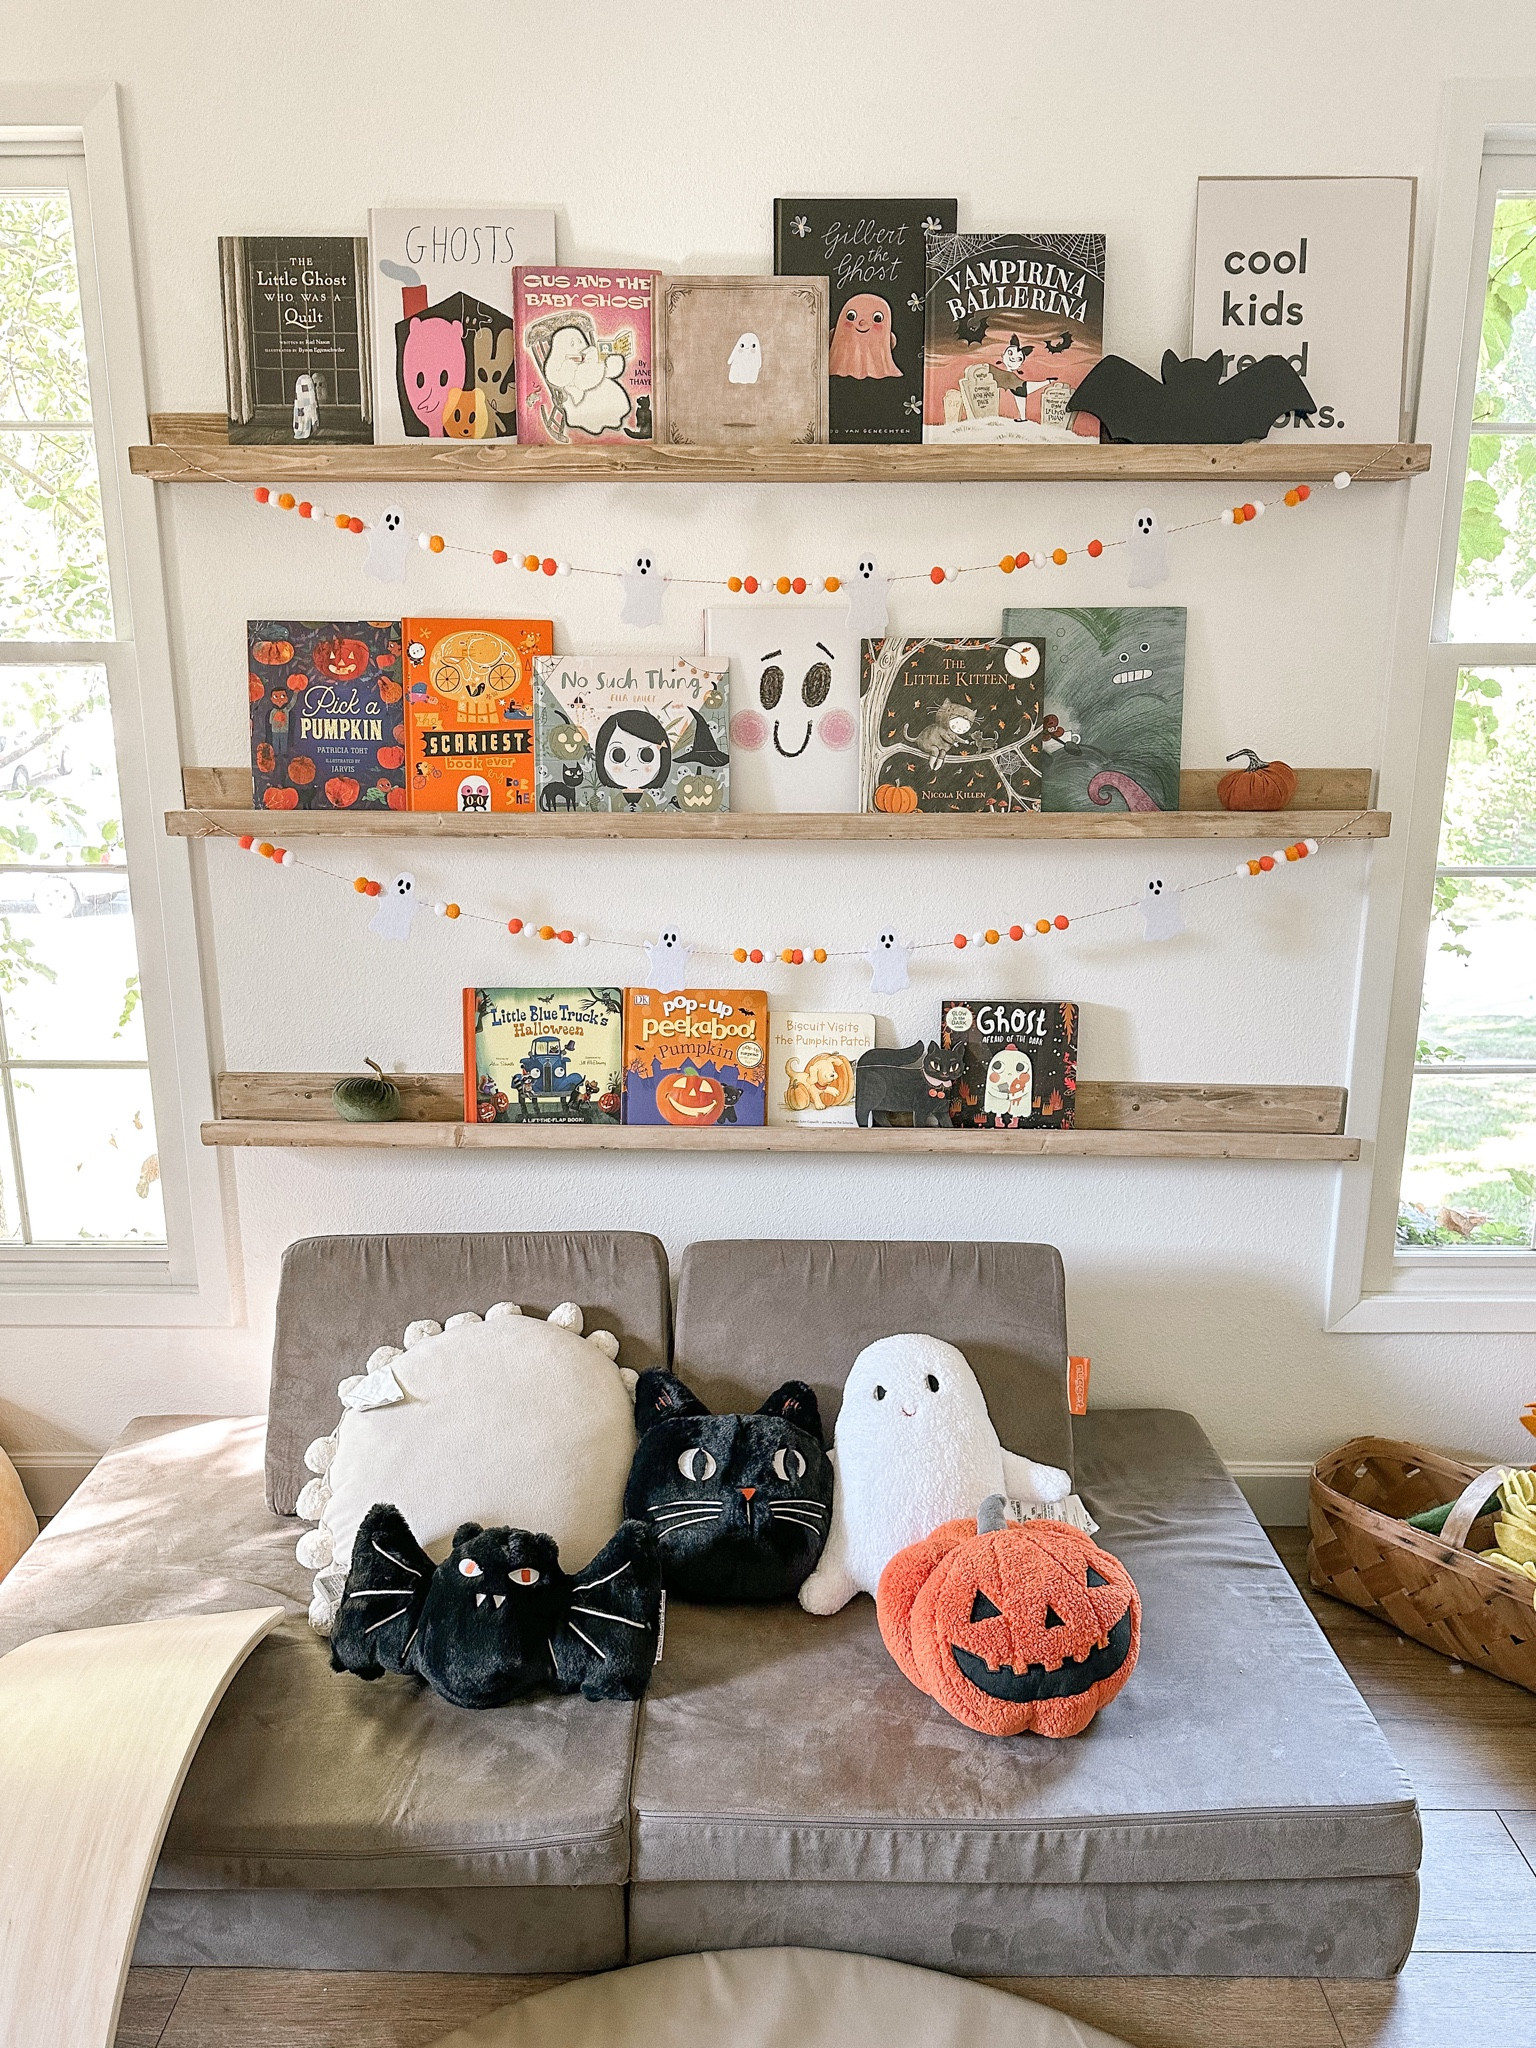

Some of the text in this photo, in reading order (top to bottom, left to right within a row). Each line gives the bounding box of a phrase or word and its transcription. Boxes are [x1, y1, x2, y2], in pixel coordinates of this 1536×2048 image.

[406, 226, 514, 264] GHOSTS
[821, 219, 909, 260] Gilbert
[290, 258, 313, 266] THE
[868, 246, 890, 262] the
[1224, 238, 1308, 275] cool
[257, 271, 346, 286] Little Ghost
[833, 254, 902, 290] Ghost
[945, 259, 1087, 299] VAMPIRINA
[523, 274, 651, 290] GUS AND THE
[264, 294, 341, 302] WHO WAS A
[525, 294, 651, 310] BABY GHOST
[946, 286, 1088, 324] BALLERINA
[1222, 290, 1304, 326] kids
[284, 308, 322, 329] Quilt
[638, 360, 646, 368] By
[1221, 342, 1308, 377] red
[943, 658, 966, 670] THE
[561, 668, 702, 699] No Such Thing
[904, 672, 1008, 687] LITTLE KITTEN
[302, 685, 381, 717] Pick a
[300, 717, 383, 742] PUMPKIN
[430, 732, 524, 754] SCARIEST
[447, 758, 514, 768] book ever
[487, 770, 505, 784] by
[922, 791, 986, 800] NICOLA KILLEN
[635, 996, 649, 1004] DK
[662, 996, 733, 1018] pop-up
[490, 1004, 608, 1026] Little Blue Truck's
[514, 1022, 584, 1038] Halloween
[642, 1016, 756, 1042] peekaboo!
[786, 1020, 859, 1032] Biscuit Visits
[775, 1034, 870, 1048] the Pumpkin Patch
[982, 1034, 1043, 1046] AFRAID OF THE DARK
[658, 1041, 734, 1060] Pumpkin
[1076, 1364, 1084, 1408] nugget
